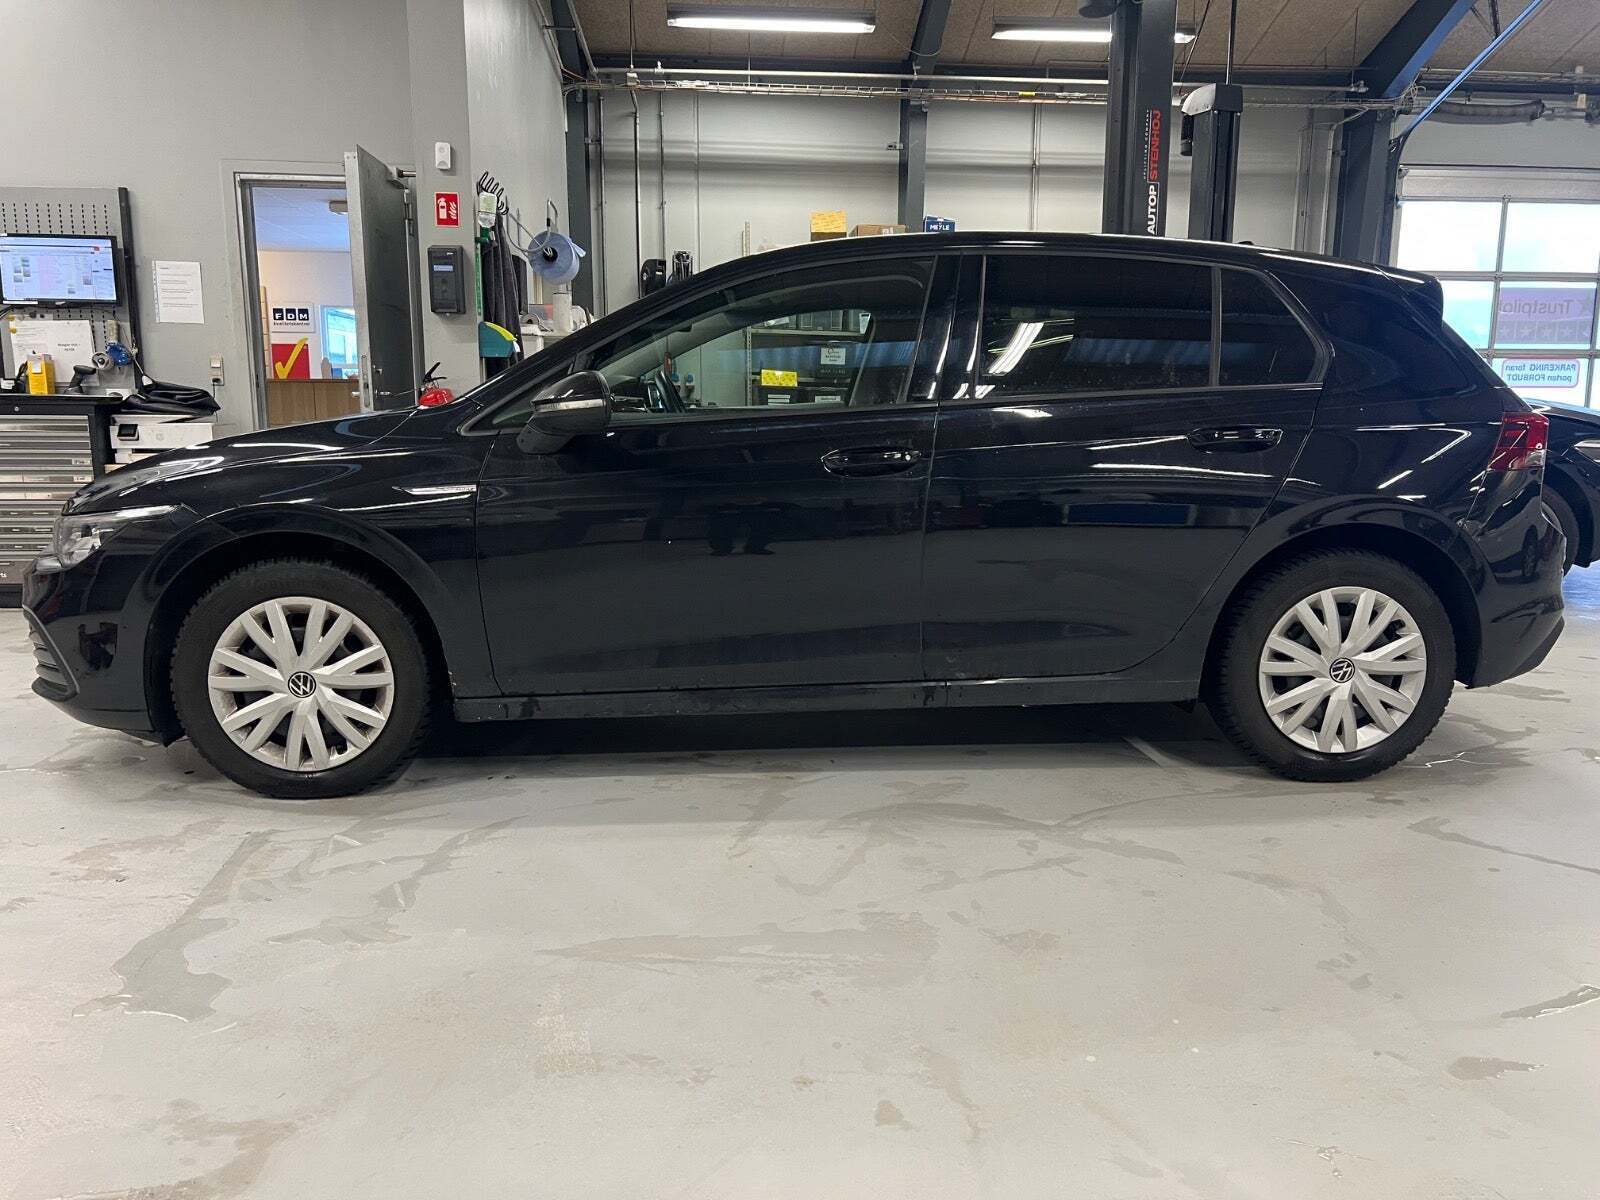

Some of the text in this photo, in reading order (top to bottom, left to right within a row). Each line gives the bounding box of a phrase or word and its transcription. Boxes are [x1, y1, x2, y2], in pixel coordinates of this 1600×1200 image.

[1147, 185, 1158, 235] AUTOP
[929, 223, 950, 231] MEYLE
[275, 312, 308, 320] FDM
